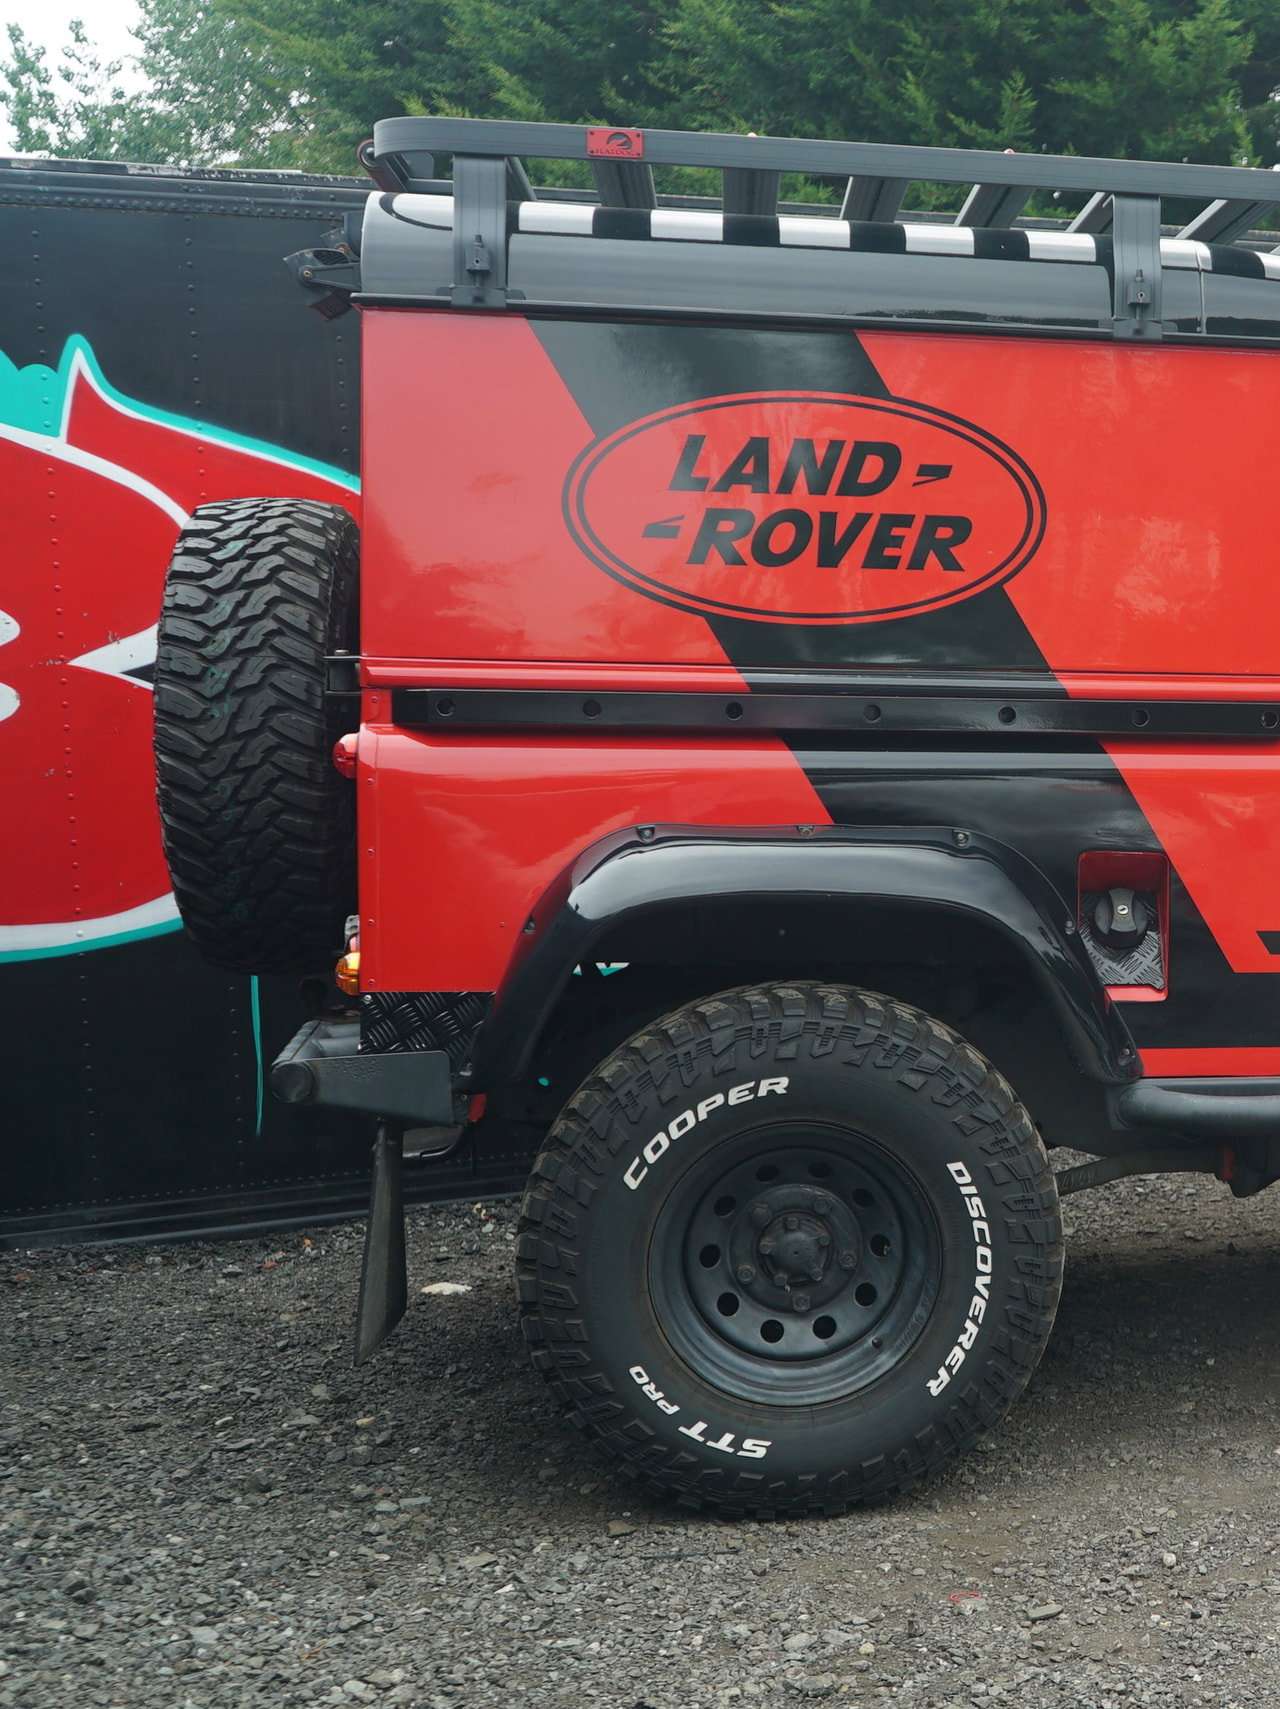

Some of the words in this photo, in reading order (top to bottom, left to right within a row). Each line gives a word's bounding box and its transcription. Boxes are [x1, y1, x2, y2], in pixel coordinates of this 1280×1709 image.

[668, 434, 902, 497] LAND
[687, 507, 972, 572] ROVER
[623, 1076, 790, 1190] COOPER
[925, 1161, 992, 1397] DISCOVERER
[629, 1365, 681, 1415] PRO
[678, 1420, 772, 1459] STT
